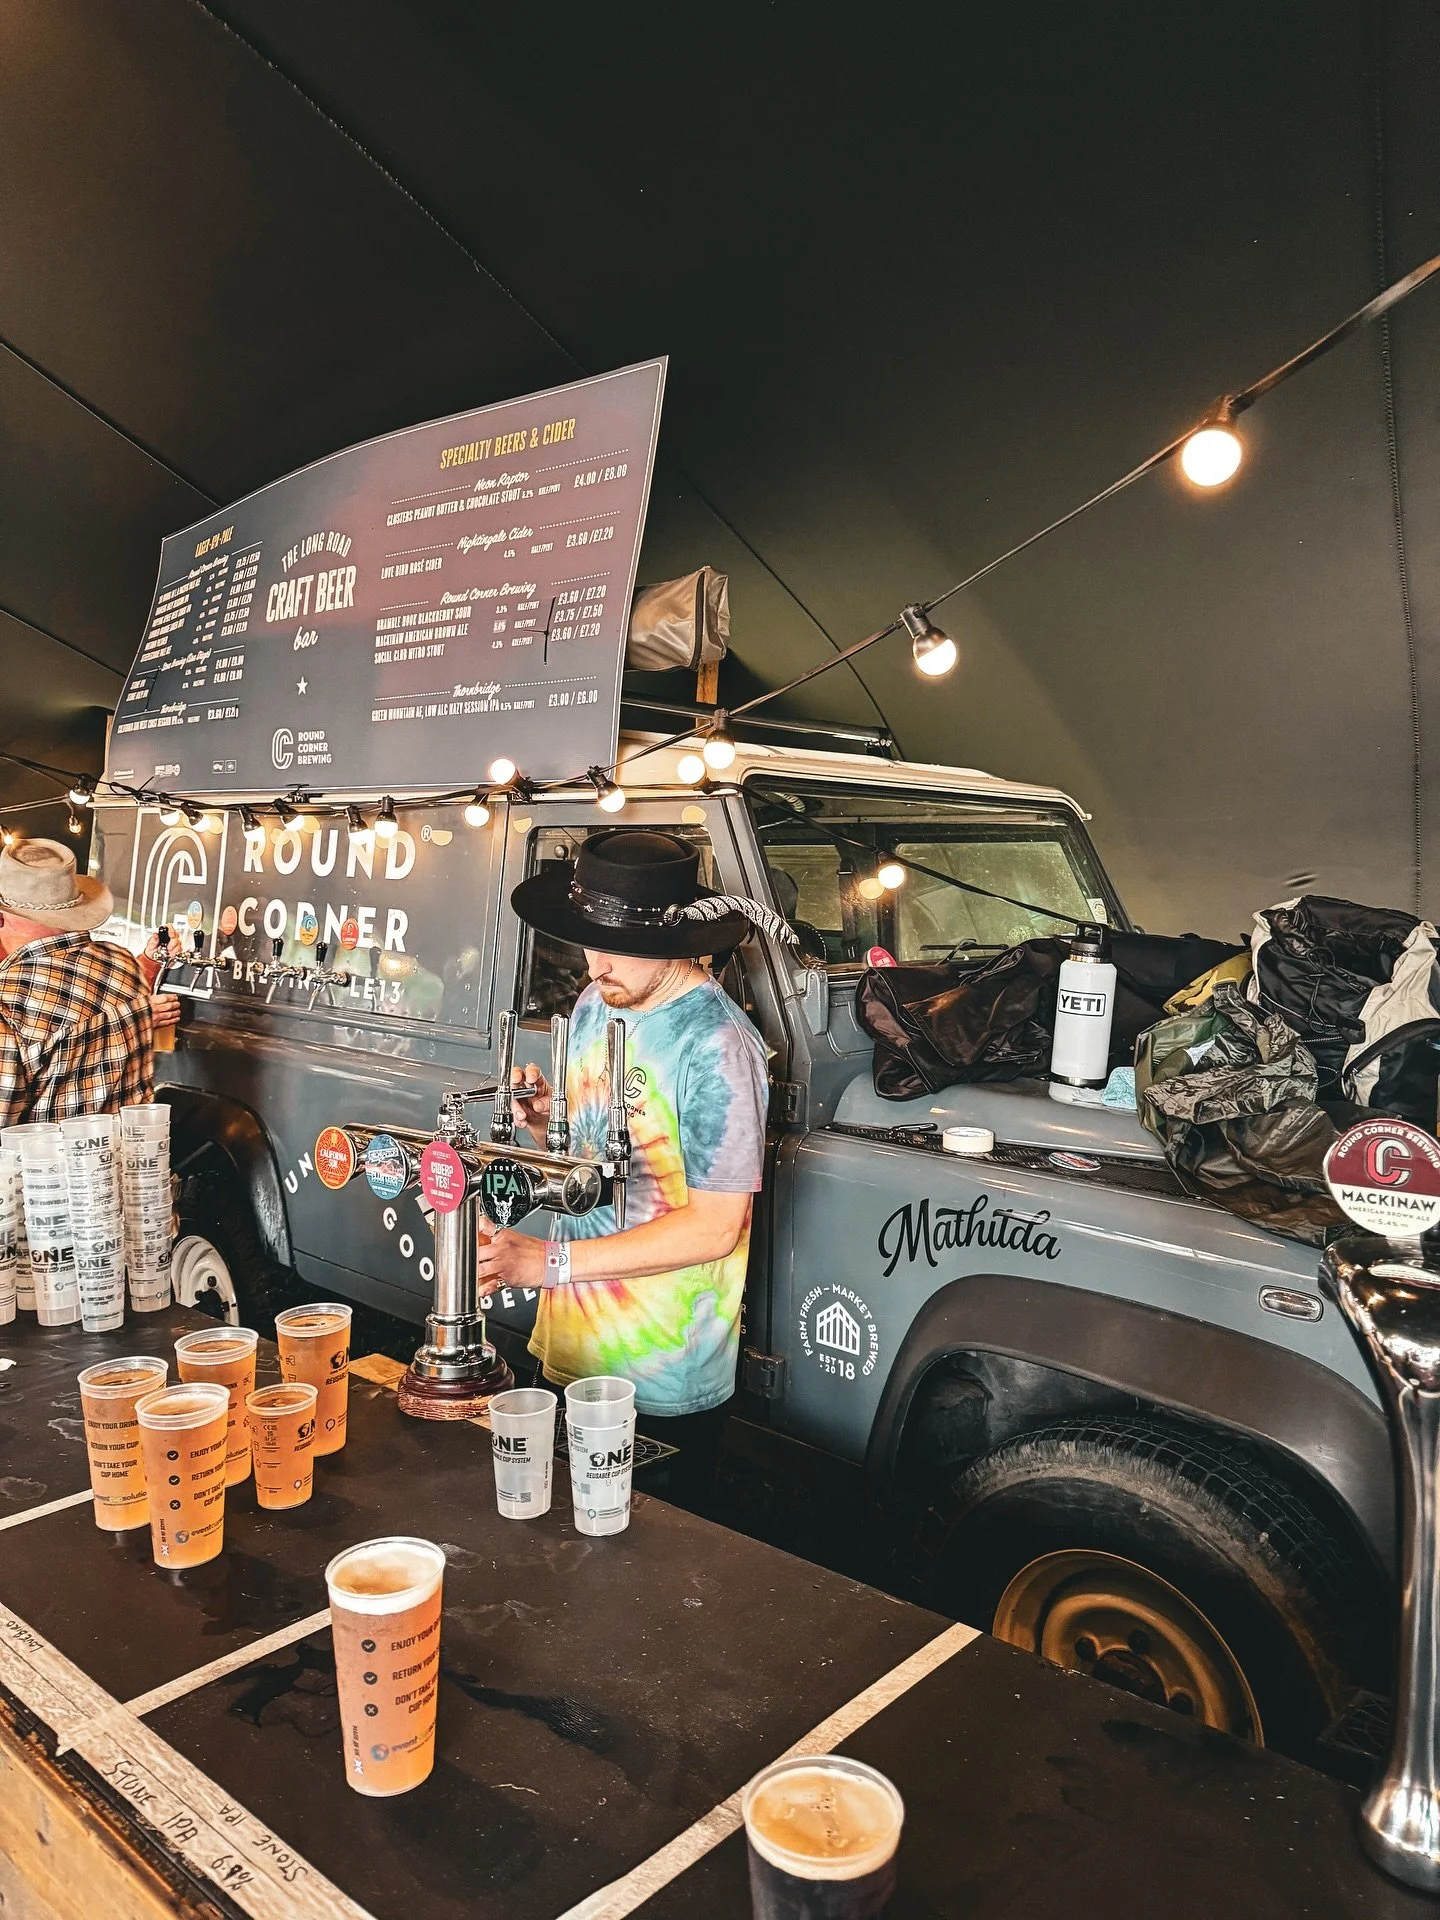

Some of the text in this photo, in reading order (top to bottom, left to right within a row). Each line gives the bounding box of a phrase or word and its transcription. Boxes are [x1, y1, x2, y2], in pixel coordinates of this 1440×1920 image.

[439, 418, 576, 470] SPECIALTY BEERS & CIDER
[413, 505, 436, 521] PEANUT
[436, 501, 458, 516] BUTTER
[458, 500, 465, 511] &
[466, 492, 501, 510] CHOCOLATE
[501, 488, 521, 503] STOUT
[574, 471, 596, 488] £4.00
[604, 464, 628, 481] £8.00
[474, 470, 530, 492] Neon Raptor
[457, 526, 534, 554] Nightingale Cider
[281, 530, 352, 574] THE LONG ROAD
[380, 566, 395, 580] LOVE
[409, 558, 425, 575] ROSÉ
[425, 557, 443, 572] CIDER
[565, 531, 588, 548] £3.60
[266, 565, 357, 623] CRAFT BEER
[440, 583, 536, 606] Round Corner Brewing
[376, 616, 401, 632] BRAMBLE
[418, 609, 455, 625] BLACKBERRY
[454, 606, 472, 620] SOUR
[557, 593, 579, 606] £3.60
[586, 585, 607, 601] £7.20
[404, 628, 434, 643] AMERICAN
[434, 625, 457, 640] BROWN
[457, 623, 469, 637] ALE
[554, 610, 576, 624] £3.75
[582, 604, 604, 619] £7.50
[293, 626, 319, 651] bar
[374, 650, 393, 665] SOCIAL
[393, 648, 408, 663] CLUB
[408, 645, 426, 660] NITRO
[426, 643, 445, 658] STOUT
[551, 629, 572, 642] £3.60
[579, 623, 601, 638] £7.20
[453, 681, 502, 701] Thornbridge
[371, 709, 388, 722] GREEN
[388, 706, 415, 721] MOUNTAIN
[424, 704, 438, 717] LOW
[438, 703, 449, 716] ALC
[449, 702, 463, 715] HAZY
[463, 699, 489, 714] SESSION
[489, 698, 500, 712] IPA
[548, 693, 570, 707] £3.00
[576, 690, 598, 704] £6.00
[298, 731, 325, 742] ROUND
[298, 742, 328, 753] CORNER
[298, 753, 332, 765] BREWING
[1060, 993, 1103, 1013] YETI
[320, 1149, 347, 1162] CALIFORNIA
[1337, 1125, 1440, 1169] ROUND CORNER BREWING
[430, 1161, 454, 1176] CIDER?
[488, 1164, 517, 1172] STONE
[435, 1174, 450, 1190] YES!
[485, 1173, 522, 1196] IPA
[1342, 1189, 1436, 1212] MACKINAW
[1348, 1205, 1430, 1222] AMERICAN BROWN ALE
[383, 1206, 435, 1281] GOO
[878, 1194, 1062, 1278] Mathilda
[31, 1247, 74, 1263] ONE
[799, 1283, 879, 1377] FARM FRESH MARKET BREWED
[819, 1353, 837, 1365] EST
[838, 1360, 856, 1381] 18
[102, 1422, 118, 1430] YOUR
[119, 1420, 139, 1429] DRINK
[109, 1443, 126, 1451] YOUR
[126, 1440, 139, 1450] CUP
[190, 1441, 222, 1459] ENJOY YOUR
[491, 1432, 527, 1453] ONE
[106, 1461, 120, 1469] TAKE
[121, 1459, 138, 1468] YOUR
[503, 1456, 512, 1464] CUP
[589, 1444, 632, 1467] ONE
[101, 1470, 129, 1478] CUP HOME
[192, 1469, 214, 1481] RETURN
[611, 1470, 620, 1478] CUP
[194, 1488, 211, 1500] DON'T
[204, 1497, 214, 1507] CUP
[391, 1627, 433, 1652] ENJOY YOUR
[392, 1651, 436, 1680] RETURN YOUR
[395, 1679, 431, 1705] DON'T TAKE
[408, 1699, 422, 1714] CUP
[101, 1760, 157, 1807] STONE
[161, 1810, 199, 1843] IPA
[220, 1803, 309, 1884] STONE IPA
